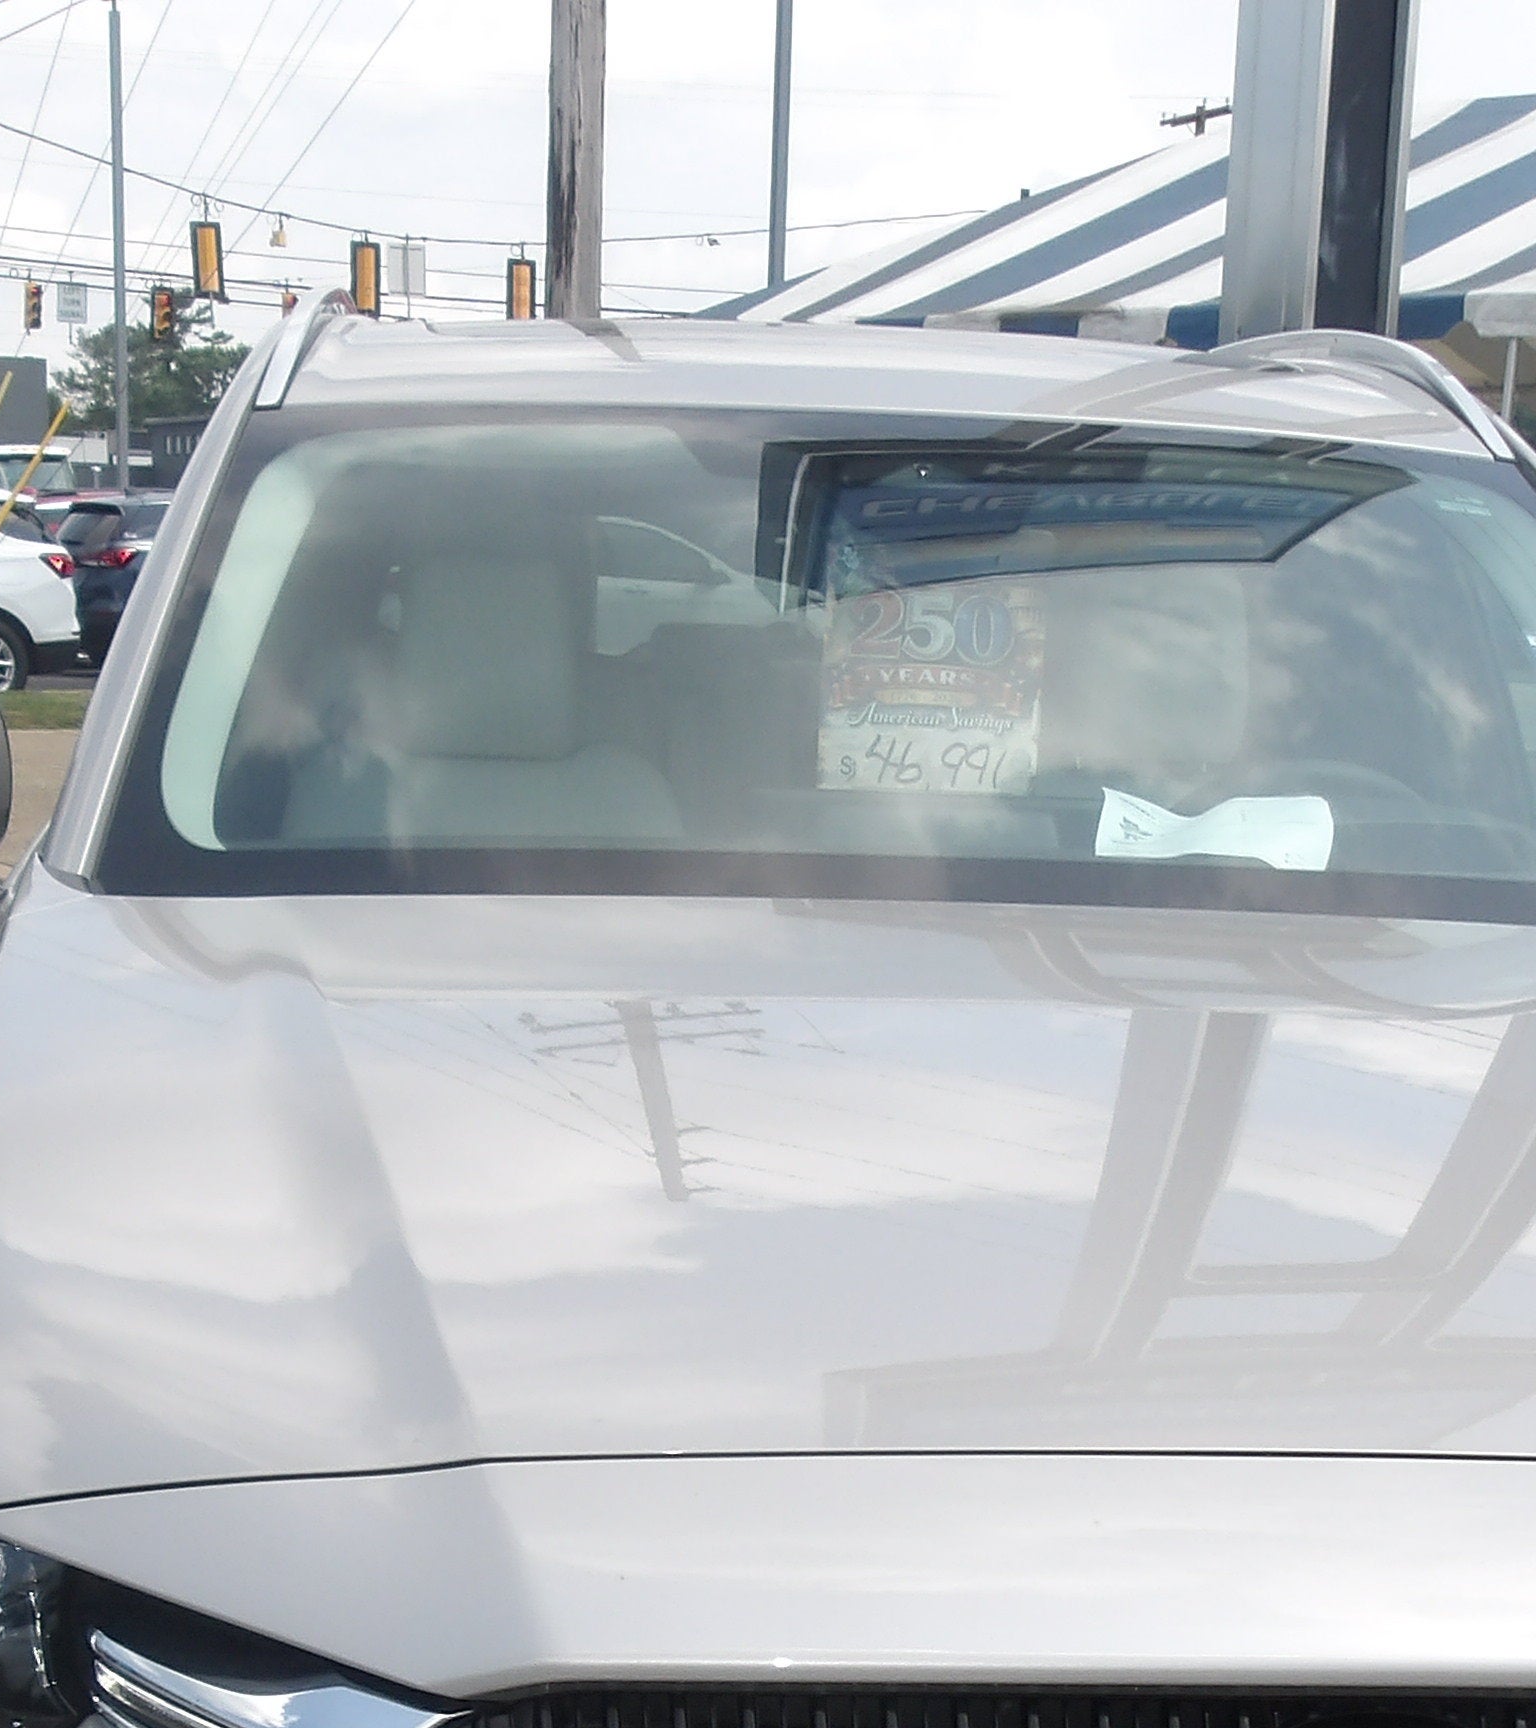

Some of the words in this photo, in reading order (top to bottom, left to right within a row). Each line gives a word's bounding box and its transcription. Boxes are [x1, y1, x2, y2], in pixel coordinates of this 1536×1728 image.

[848, 588, 1016, 665] 250
[878, 667, 977, 686] YEARS
[847, 702, 941, 728] American
[946, 706, 1014, 734] Savings
